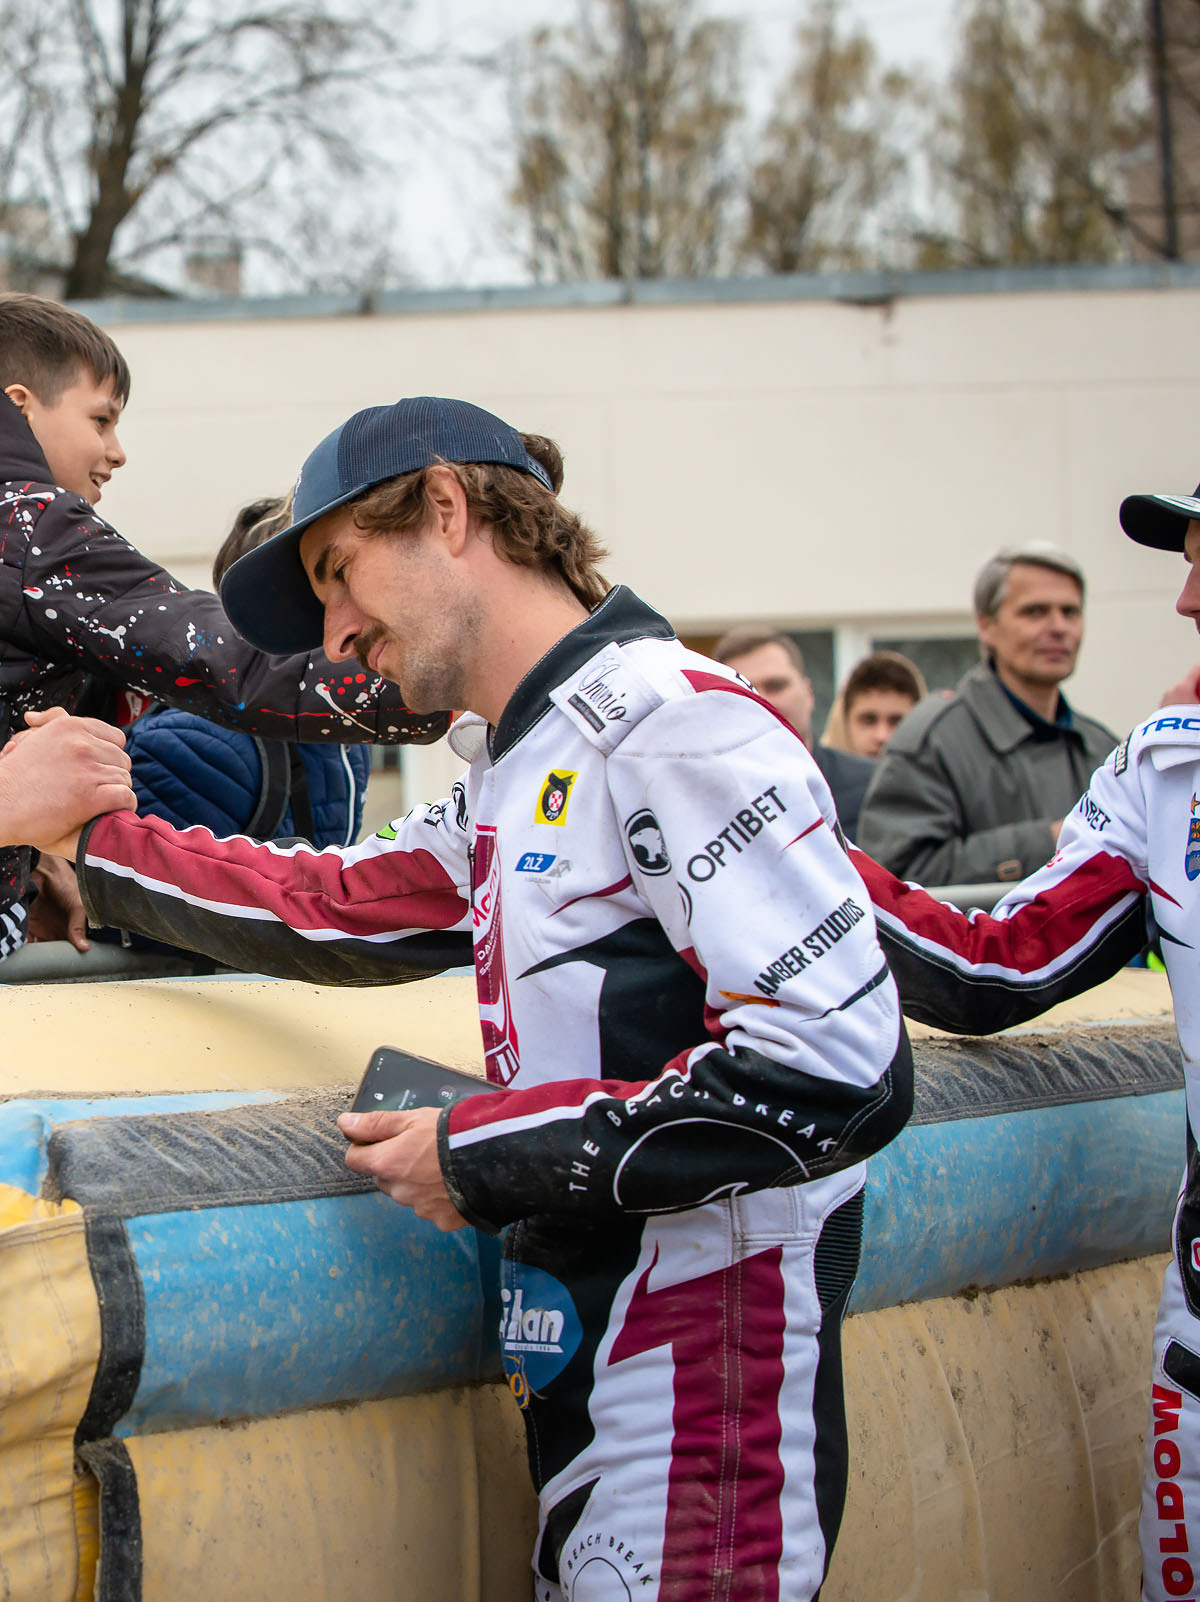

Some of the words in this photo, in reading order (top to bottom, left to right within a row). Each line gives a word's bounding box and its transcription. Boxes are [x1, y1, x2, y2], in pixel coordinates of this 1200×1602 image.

[687, 785, 788, 882] OPTIBET
[753, 946, 813, 998] AMBER
[801, 897, 866, 959] STUDIOS
[569, 1139, 601, 1192] THE
[1152, 1383, 1196, 1602] OLDOW
[608, 1536, 654, 1586] BREAK
